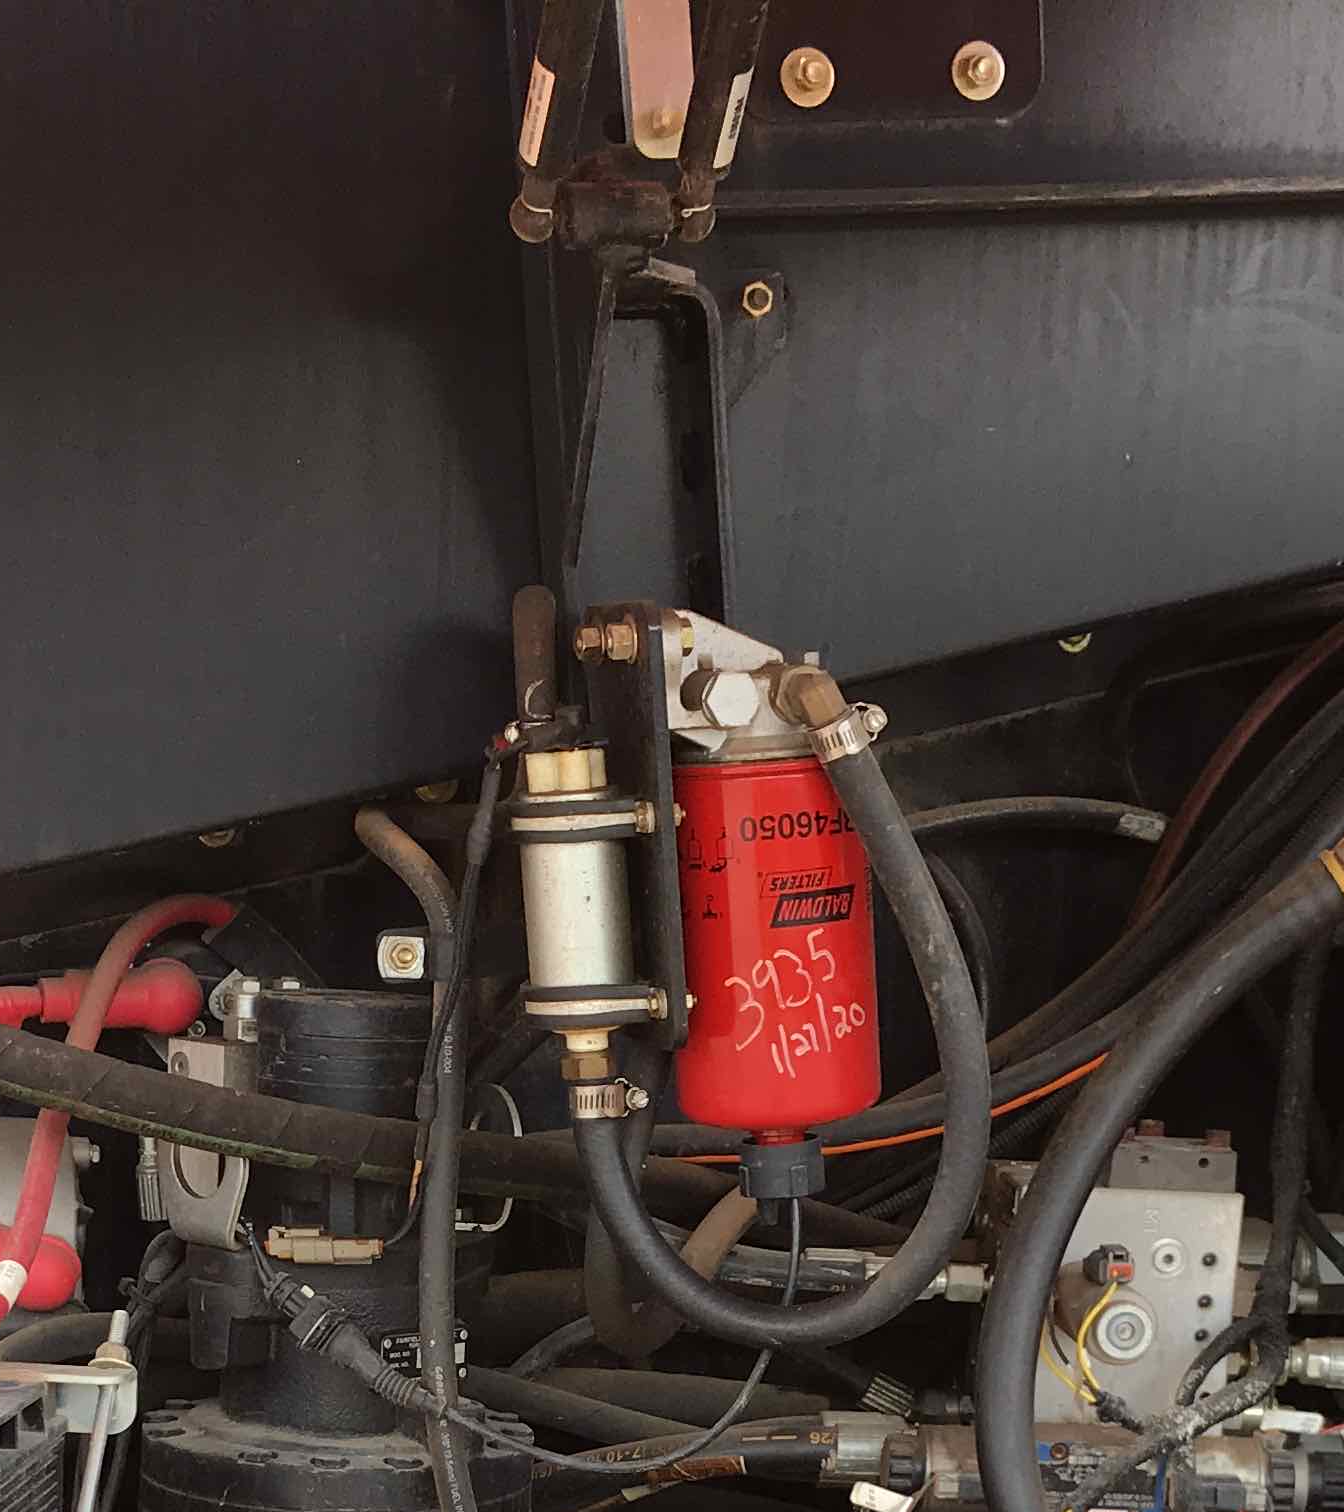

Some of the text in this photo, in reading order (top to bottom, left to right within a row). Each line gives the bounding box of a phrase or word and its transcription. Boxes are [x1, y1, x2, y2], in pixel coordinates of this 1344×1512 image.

[770, 872, 825, 892] FILTERS
[777, 892, 851, 922] BALDWIN
[724, 928, 836, 1051] 3935
